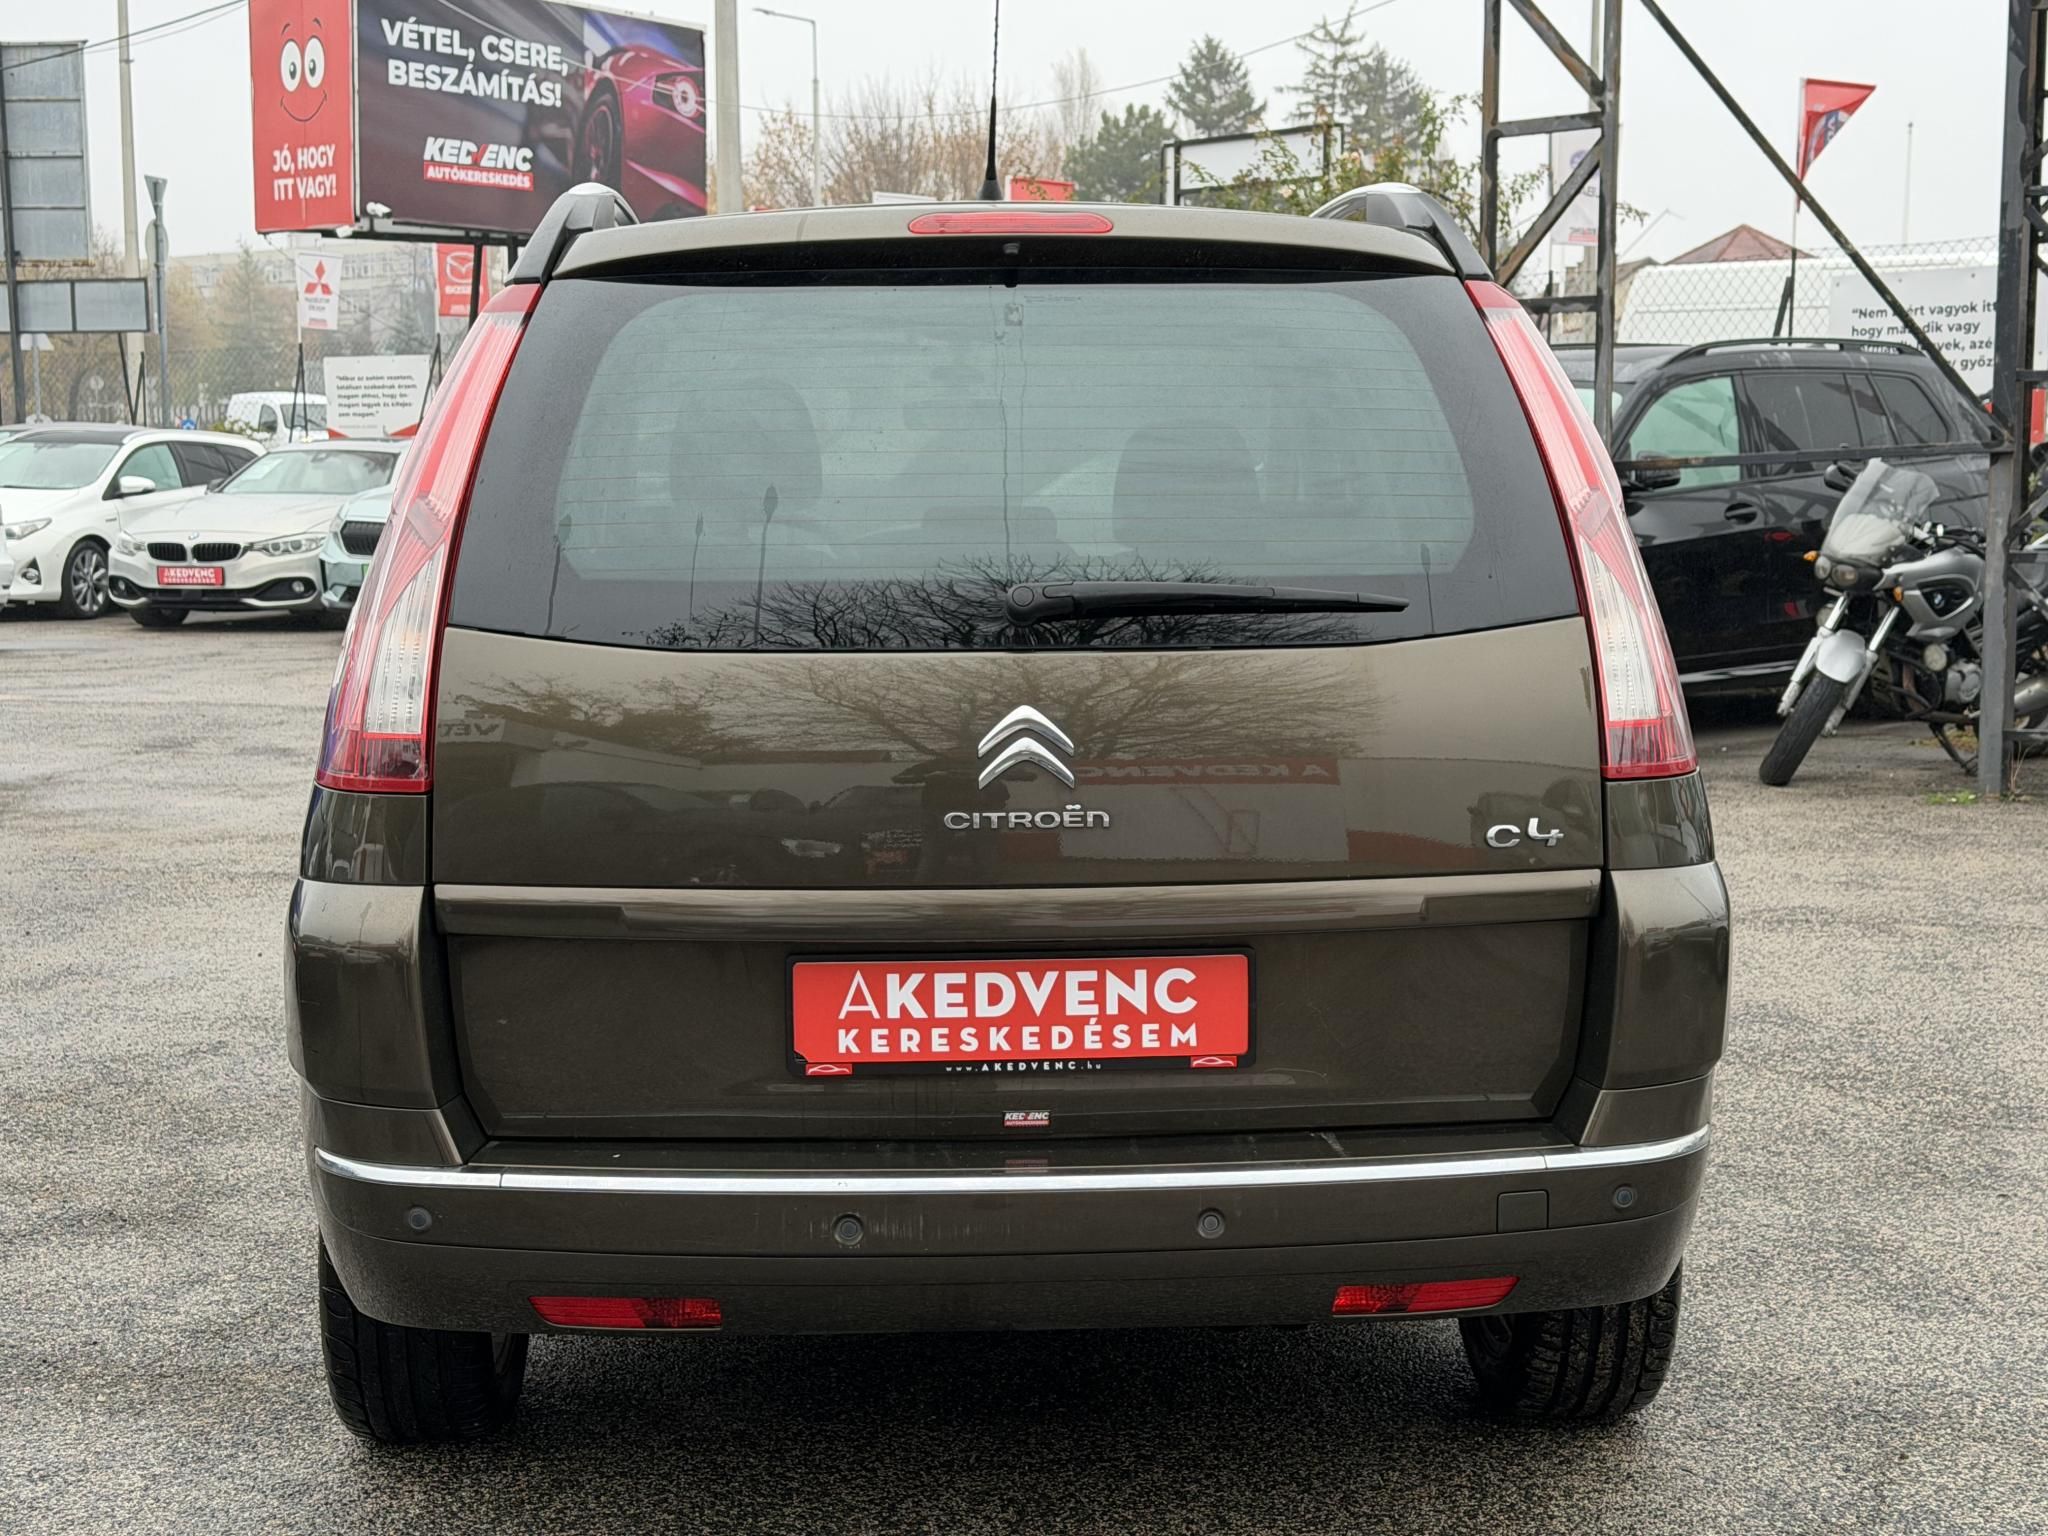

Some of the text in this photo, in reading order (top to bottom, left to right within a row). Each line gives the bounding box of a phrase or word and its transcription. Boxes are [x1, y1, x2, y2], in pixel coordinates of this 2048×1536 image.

[380, 16, 569, 77] VÉTEL, CSERE,
[387, 58, 563, 108] BESZÁMÍTÁS!
[272, 142, 336, 176] JÓ, HOGY
[274, 173, 337, 201] ITT VAGY!
[426, 165, 531, 188] AUTÓKERESKEDÉS
[1928, 302, 1978, 319] vagyok
[1851, 325, 1884, 340] hogy
[1947, 321, 1982, 335] vagy
[943, 803, 1110, 830] CITROËN
[1486, 817, 1565, 848] C4
[837, 1017, 1199, 1054] KERESKEDÉSEM
